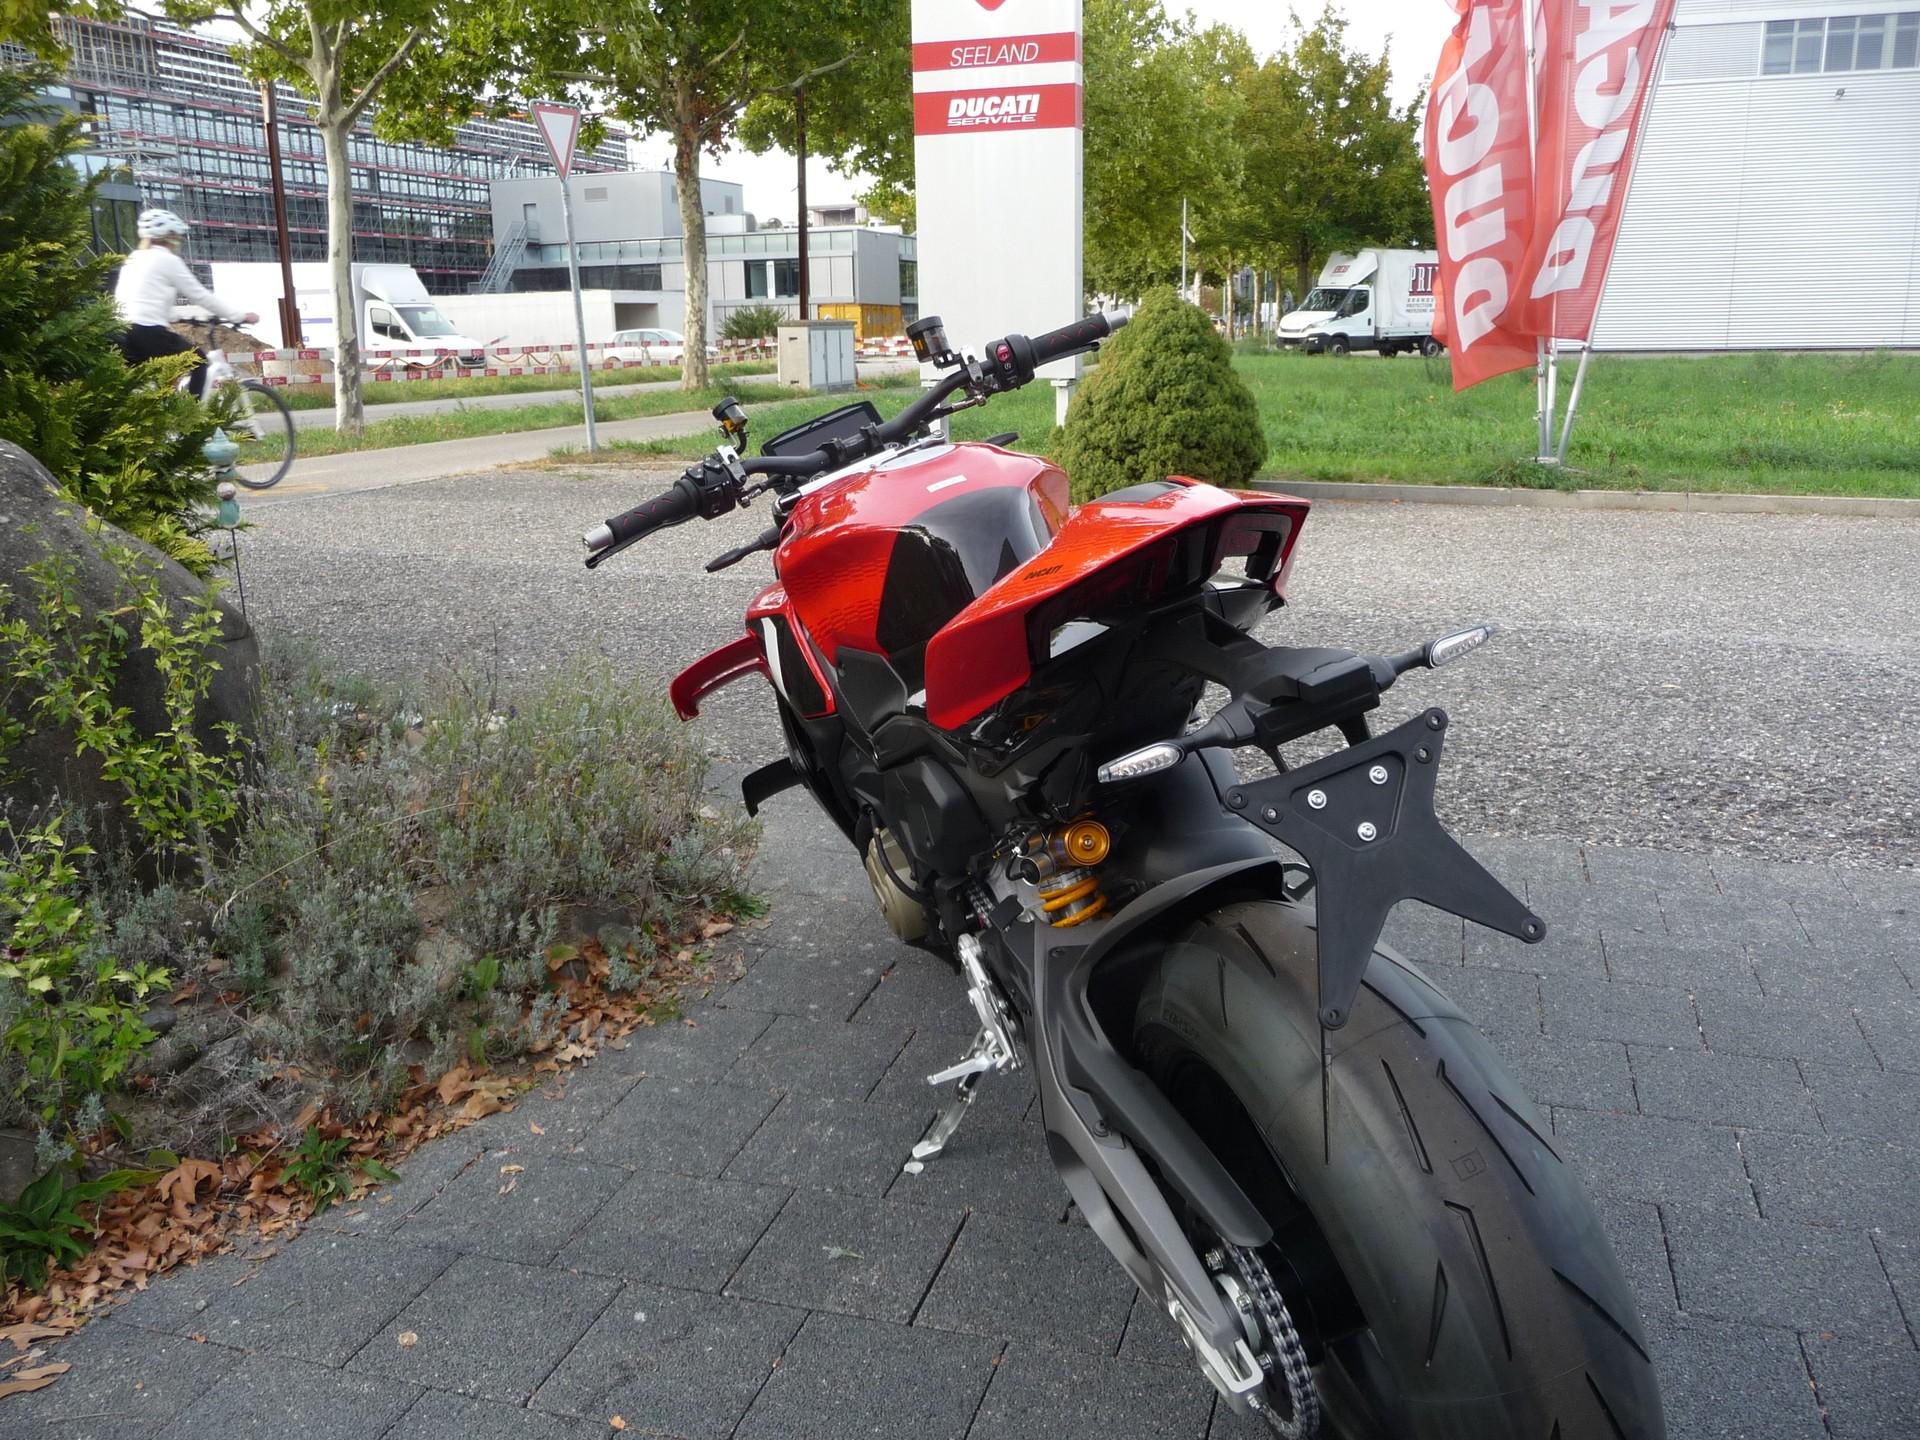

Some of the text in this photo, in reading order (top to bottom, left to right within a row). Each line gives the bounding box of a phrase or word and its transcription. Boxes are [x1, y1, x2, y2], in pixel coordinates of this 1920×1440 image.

[949, 42, 1039, 67] SEELAND
[948, 94, 1040, 118] DUCATI
[947, 113, 1037, 126] SERVICE
[1408, 267, 1439, 291] PRI
[1023, 564, 1064, 581] DUCATI
